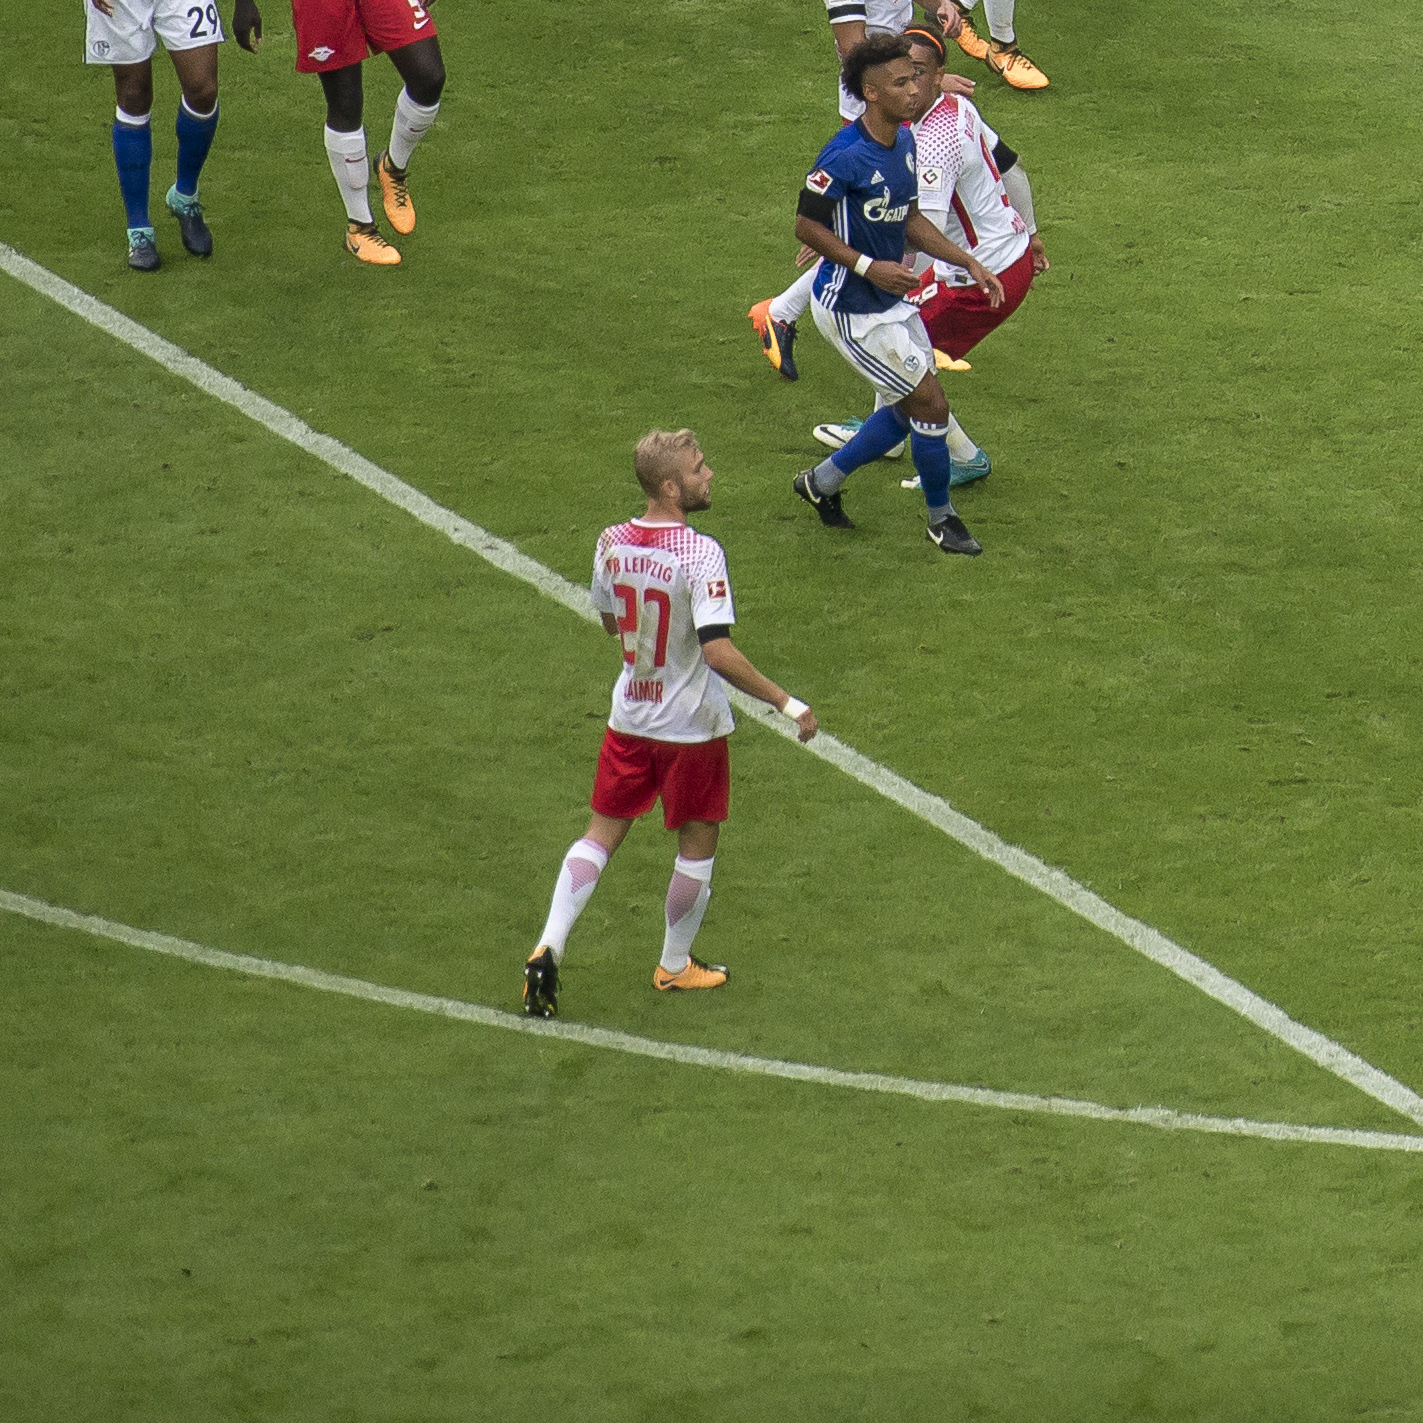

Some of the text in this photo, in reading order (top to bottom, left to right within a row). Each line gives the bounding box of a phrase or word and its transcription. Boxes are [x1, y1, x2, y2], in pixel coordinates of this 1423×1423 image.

[187, 3, 218, 39] 29
[624, 556, 673, 583] LEIPZIG
[612, 583, 671, 668] 27
